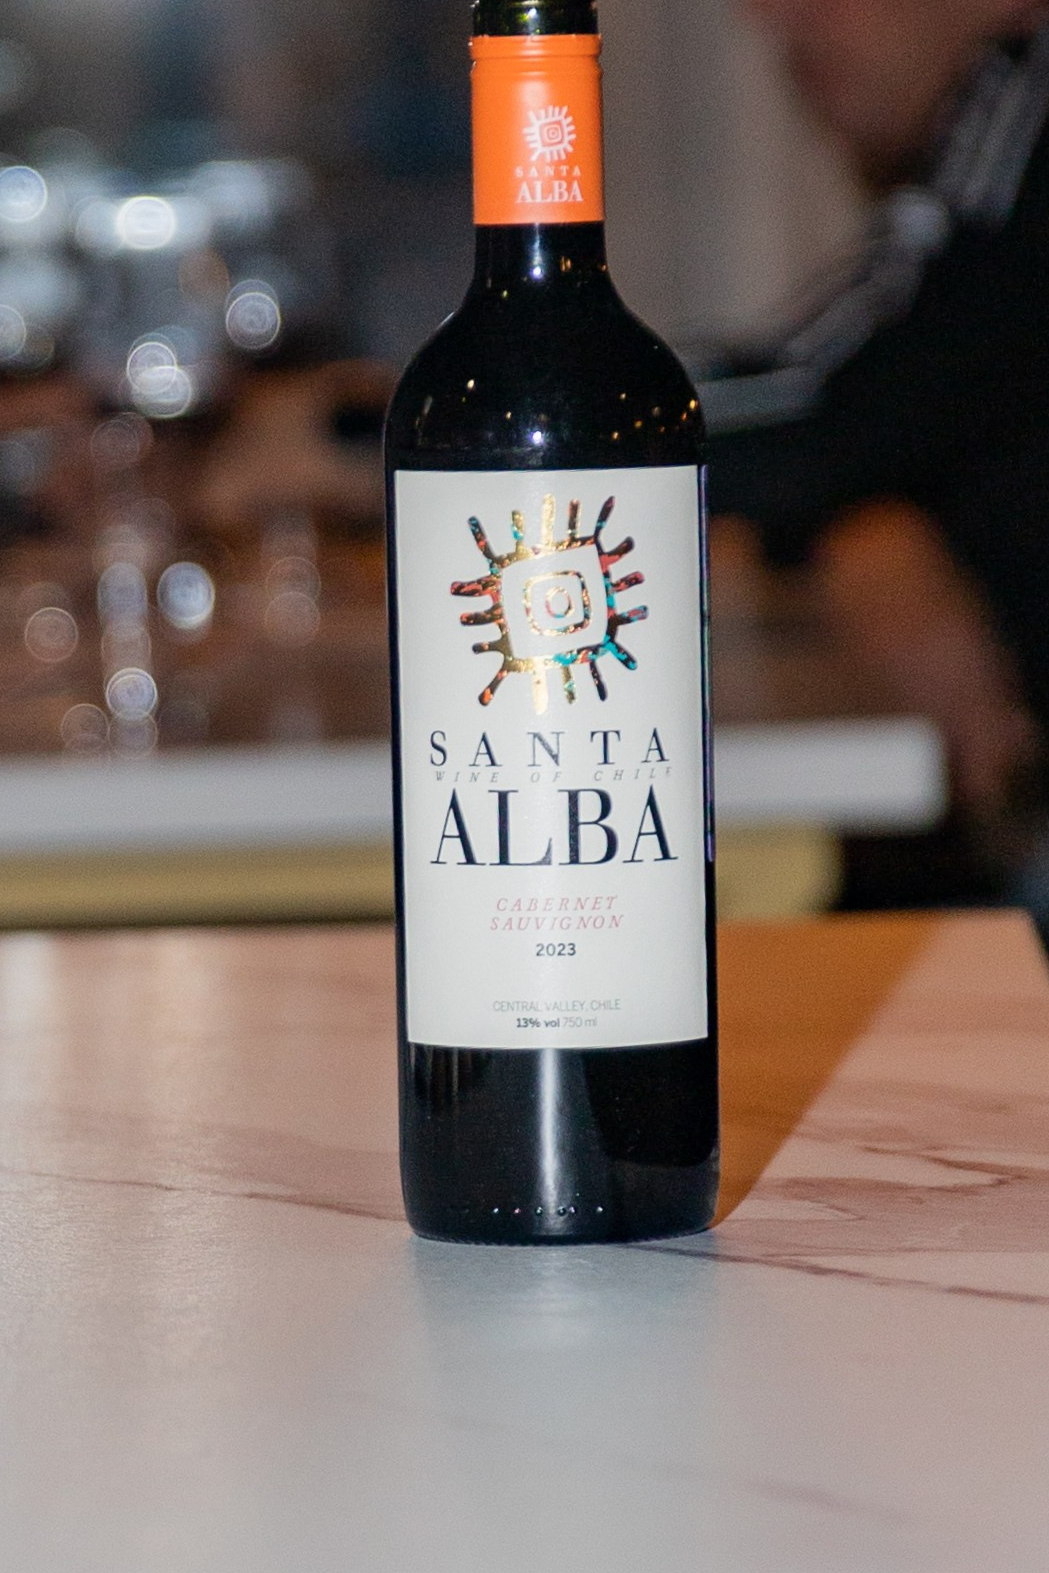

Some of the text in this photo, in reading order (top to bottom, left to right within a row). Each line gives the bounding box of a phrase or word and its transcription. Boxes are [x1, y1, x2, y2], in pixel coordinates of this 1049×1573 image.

[515, 165, 582, 177] SANTA
[516, 180, 584, 204] ALBA
[430, 727, 670, 767] SANTA
[435, 766, 673, 783] WINE OF CHILE
[430, 784, 679, 867] ALBA
[496, 896, 617, 912] CABERNET
[490, 915, 624, 931] SAUVIGNON
[535, 942, 577, 957] 2023
[493, 1000, 543, 1013] CENTRAL
[590, 998, 622, 1011] CHILE
[516, 1016, 598, 1028] 13% vol 750 ml
